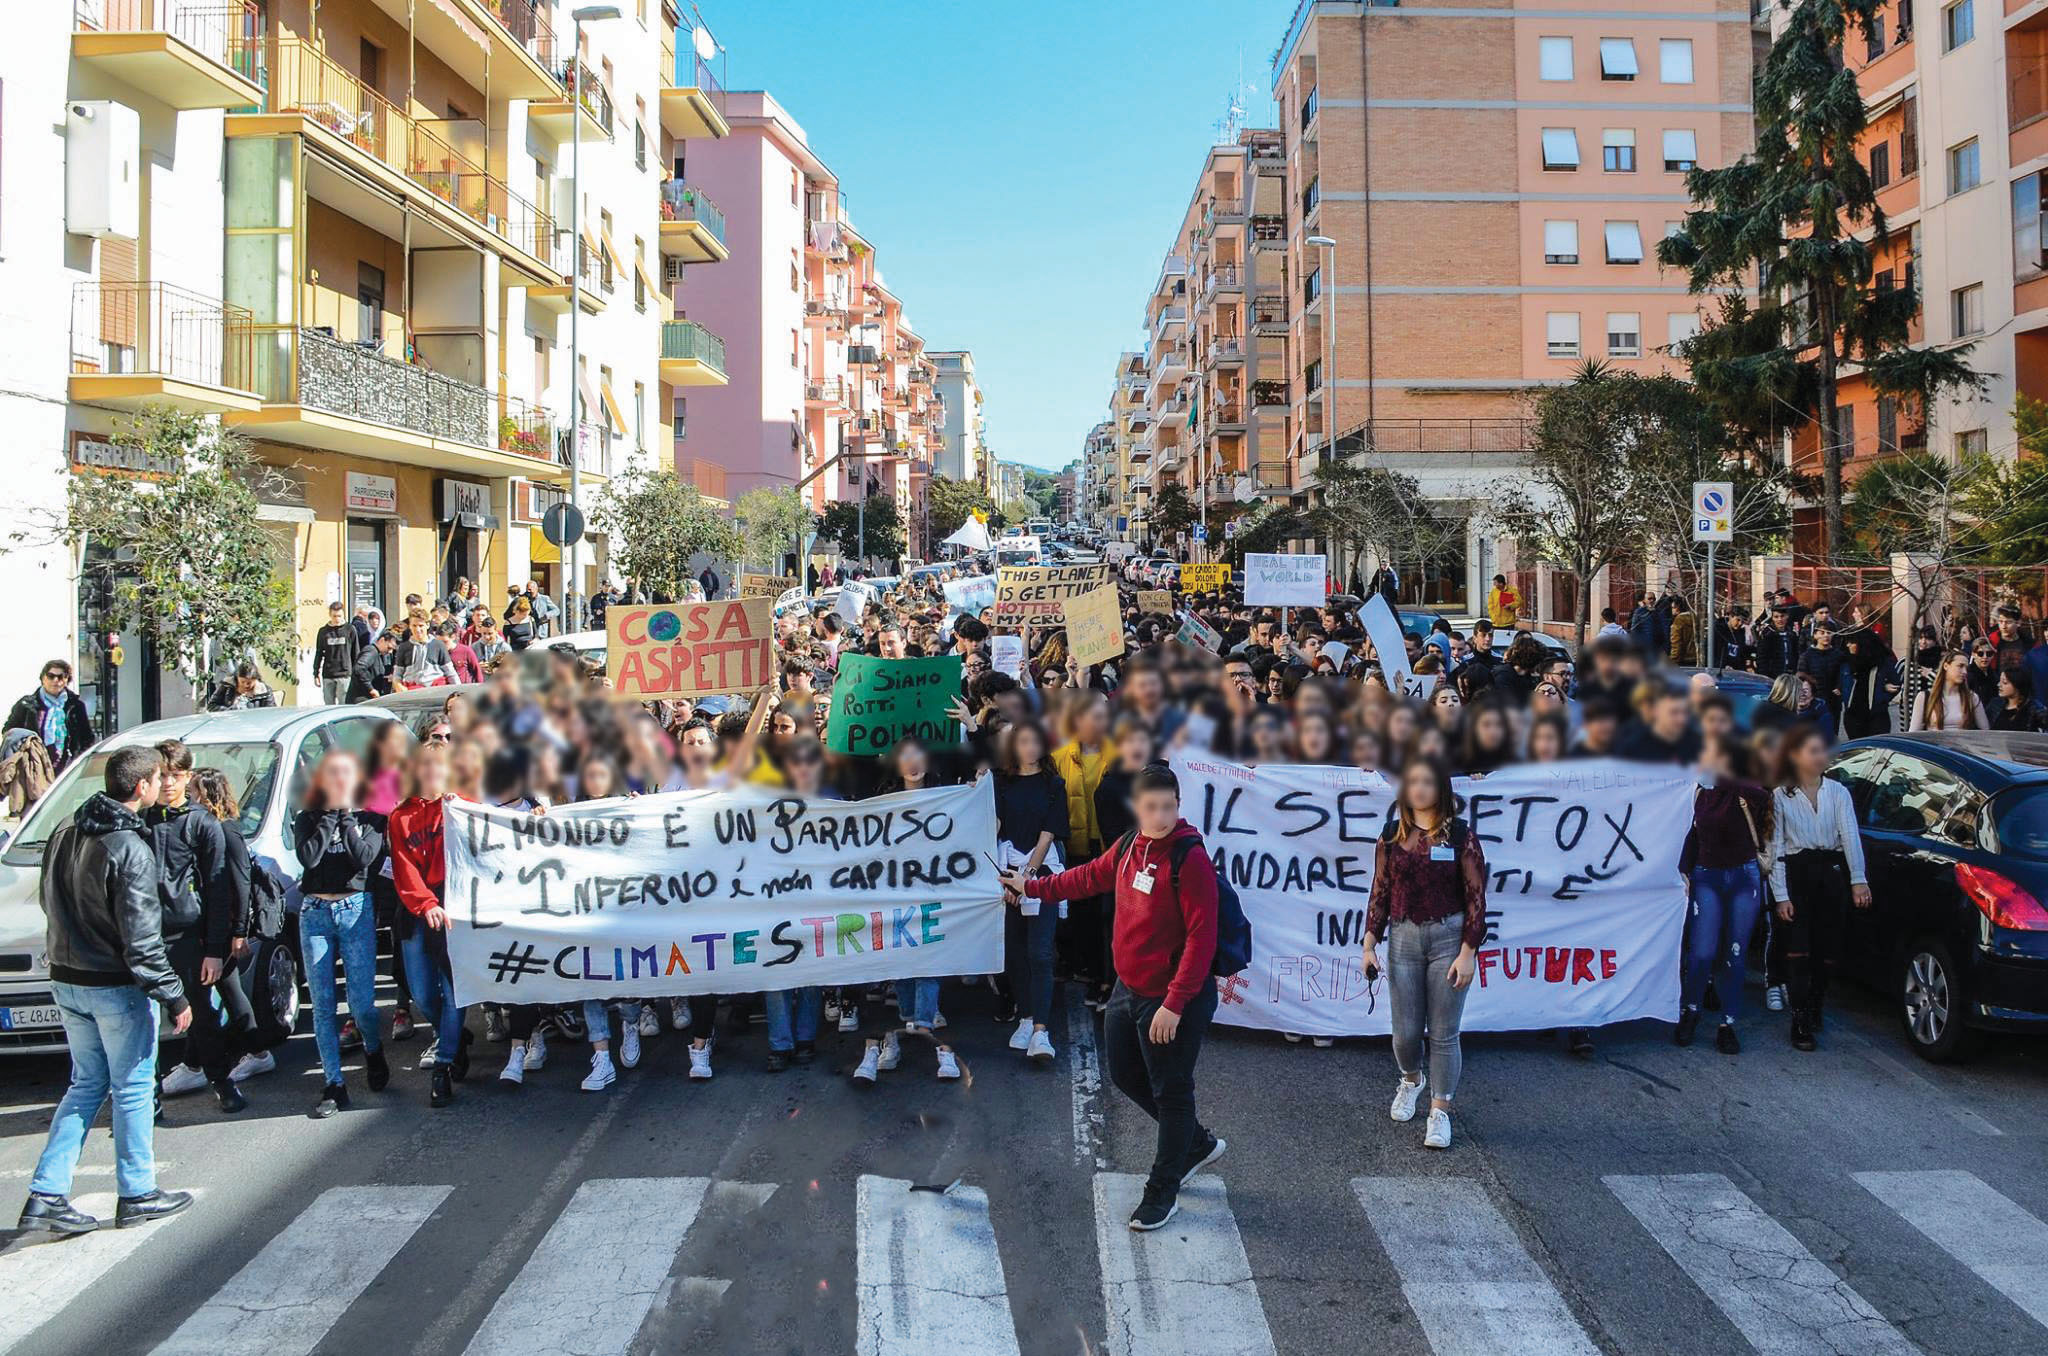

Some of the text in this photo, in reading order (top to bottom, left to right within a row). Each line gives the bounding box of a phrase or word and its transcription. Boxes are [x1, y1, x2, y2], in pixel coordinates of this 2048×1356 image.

[1292, 556, 1321, 569] THE
[1003, 564, 1109, 582] THIS PLANET
[1260, 570, 1313, 583] WORLD
[743, 586, 758, 596] PER
[767, 578, 790, 589] ANNI
[999, 586, 1013, 601] IS
[996, 602, 1062, 615] HOTTER
[997, 614, 1065, 625] MY CRU
[467, 812, 505, 858] IL
[511, 815, 631, 851] MONDO
[714, 808, 756, 845] UN
[1203, 782, 1258, 836] IL
[1603, 802, 1645, 870] X
[829, 851, 977, 891] CAPIRLO
[488, 901, 947, 986] #CLIMATESTRIKE
[12, 1010, 26, 1025] CE
